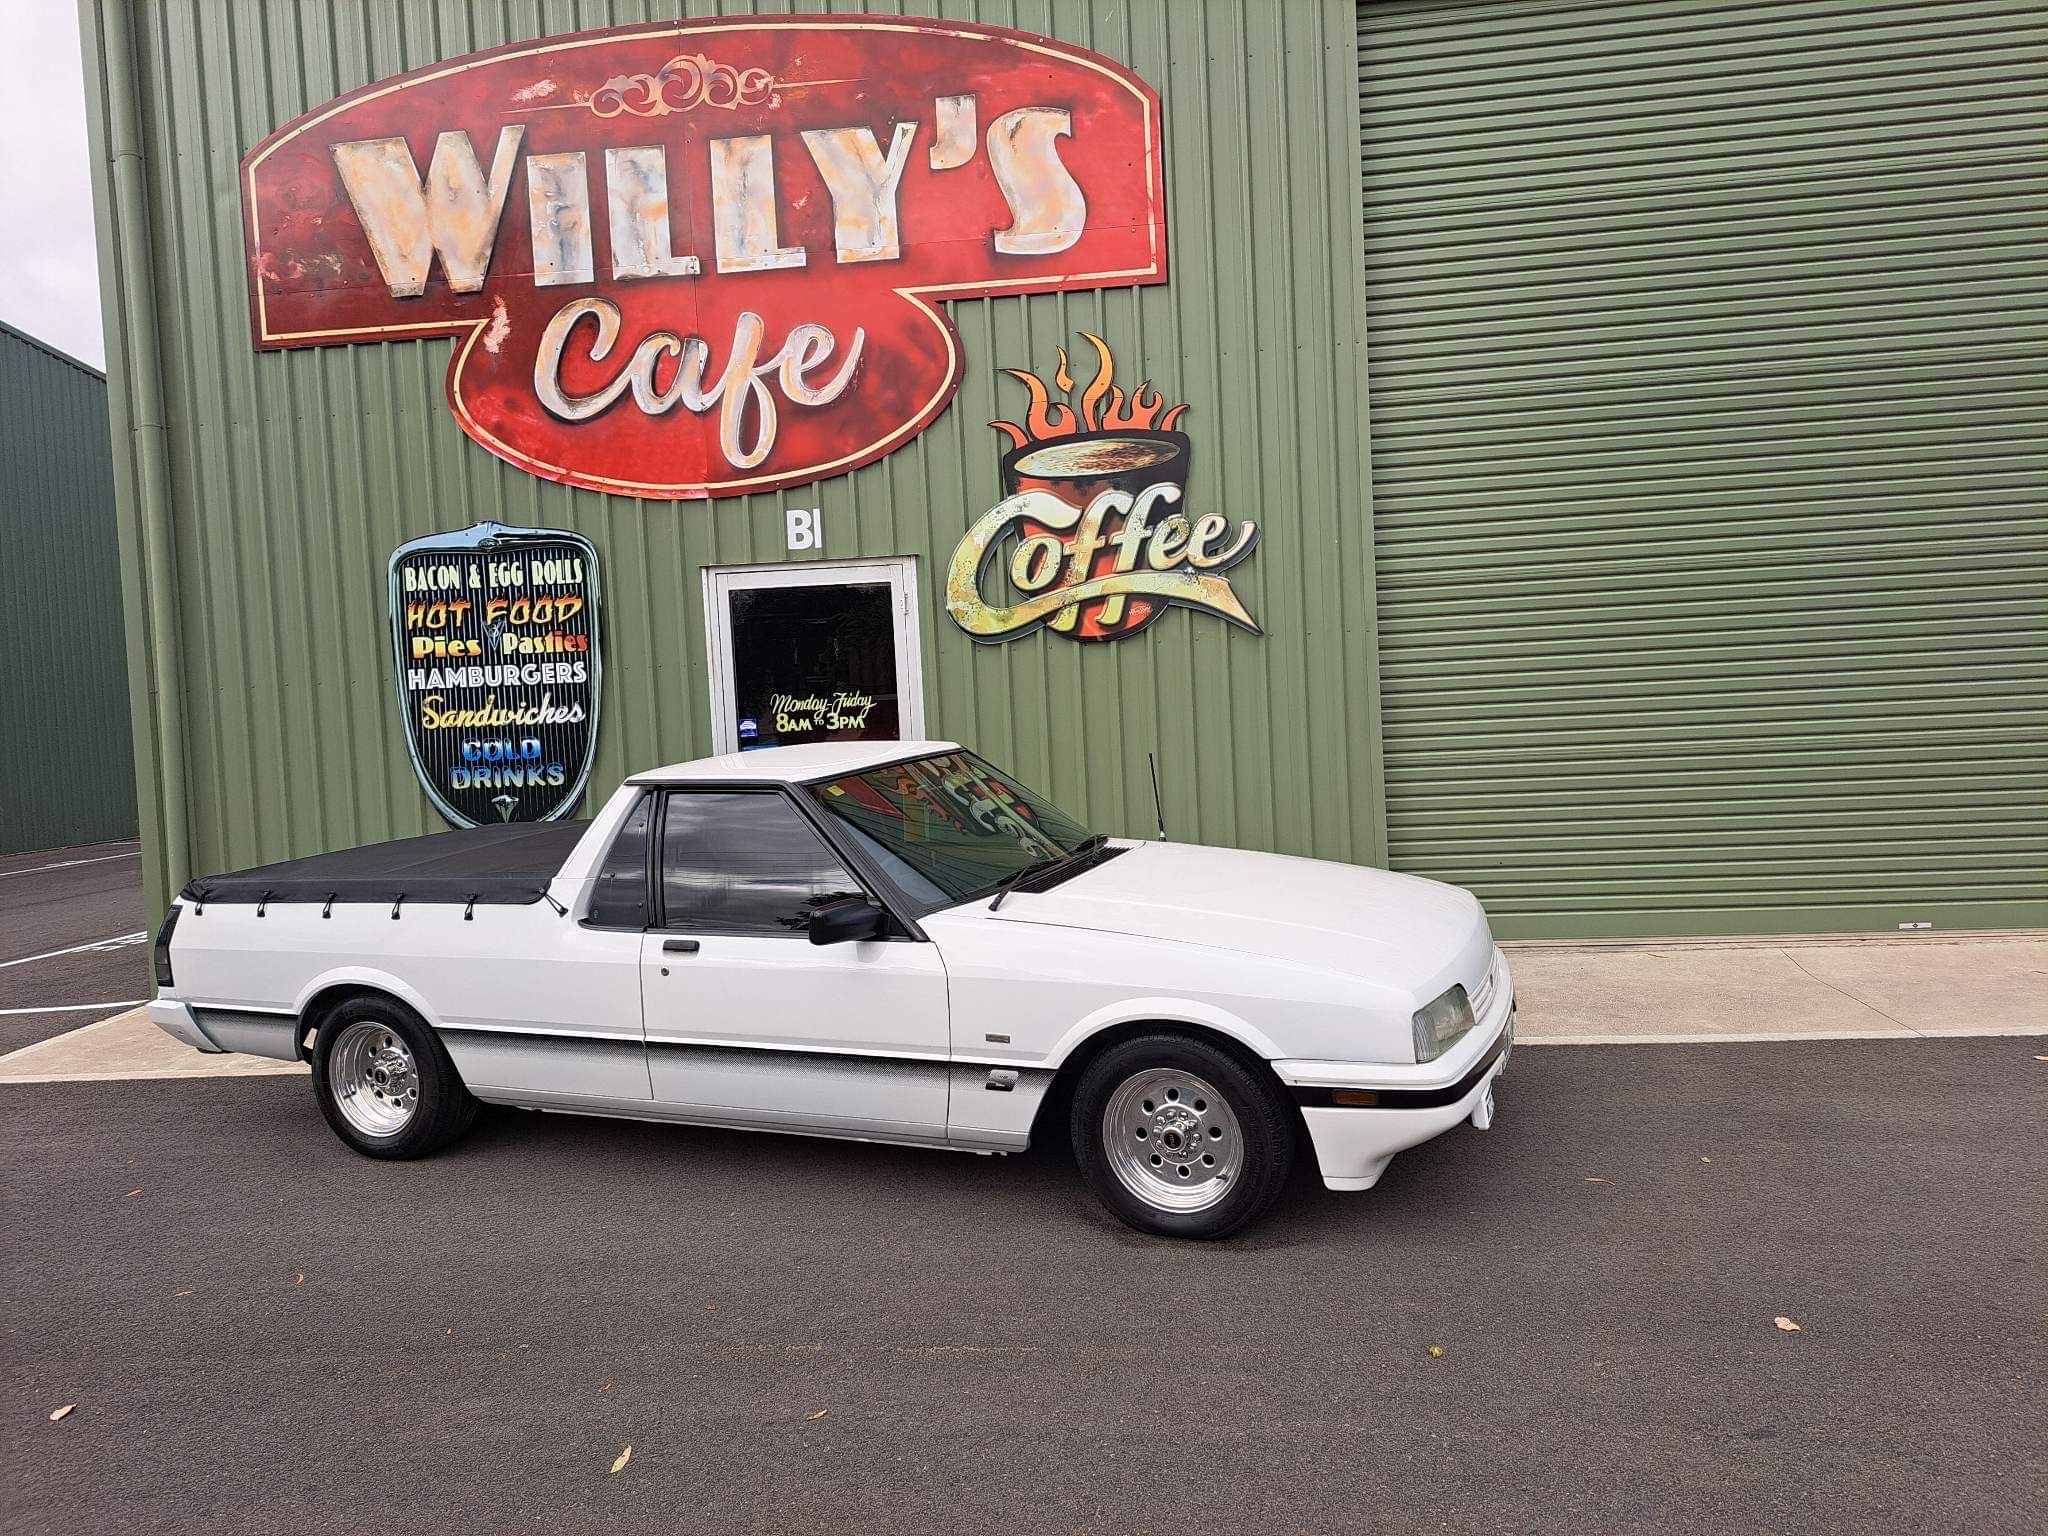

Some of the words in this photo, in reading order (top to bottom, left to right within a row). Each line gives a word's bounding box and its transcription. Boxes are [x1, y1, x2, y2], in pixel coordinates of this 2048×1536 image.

[330, 94, 1087, 297] WILLY'S
[534, 297, 866, 469] Cafe
[404, 565, 461, 592] BACON
[468, 563, 481, 589] &
[489, 561, 523, 588] EGG
[531, 558, 583, 586] ROLLS
[946, 482, 1265, 637] Coffee
[407, 598, 471, 630] HOT
[486, 593, 583, 625] FOOD
[412, 636, 482, 659] Pies
[502, 629, 589, 655] Pasties
[408, 662, 587, 690] HAMBURGERS
[422, 692, 586, 730] Sandwiches
[776, 713, 813, 733] 8AM
[826, 713, 865, 730] 3PM
[462, 738, 542, 761] COLD
[451, 763, 565, 789] DRINKS
